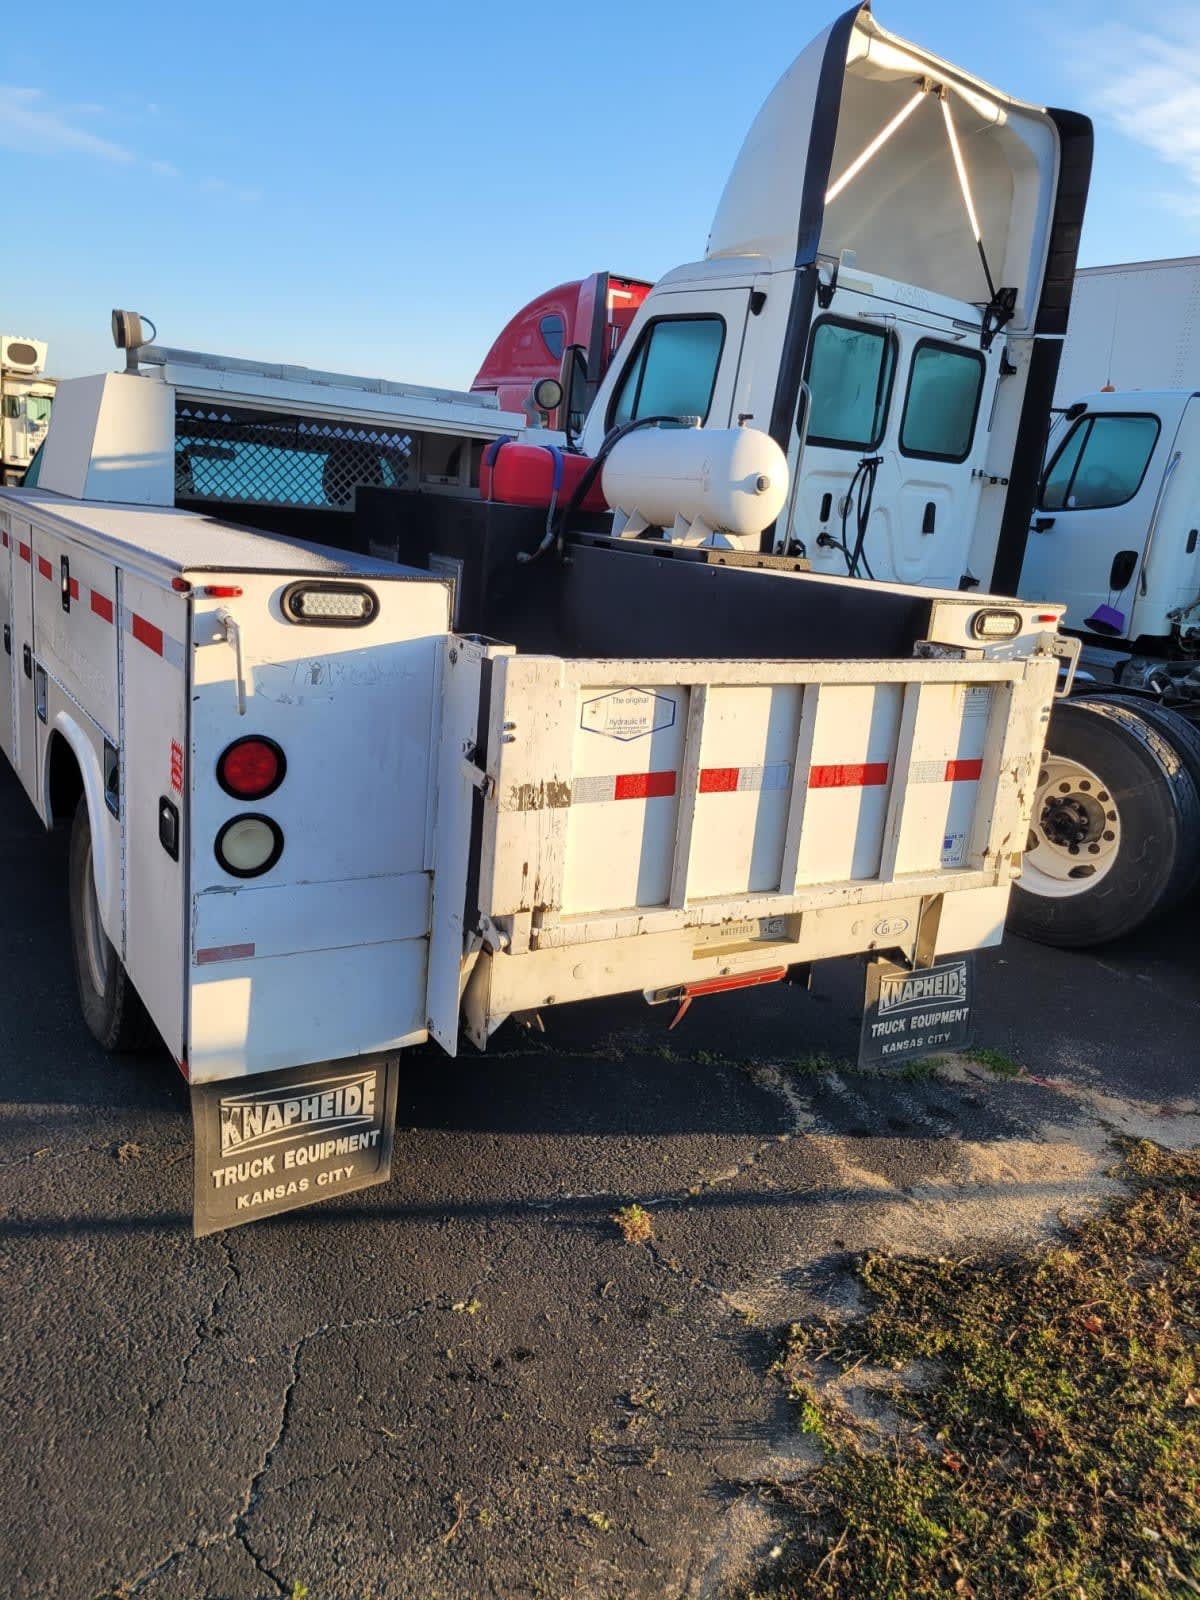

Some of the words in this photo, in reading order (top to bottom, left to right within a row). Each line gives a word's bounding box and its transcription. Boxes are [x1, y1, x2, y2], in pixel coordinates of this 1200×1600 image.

[612, 697, 624, 705] The
[625, 697, 649, 706] original
[609, 717, 638, 726] hydraulic
[879, 966, 967, 1010] KNAPHEIDE
[871, 1018, 906, 1038] TRUCK
[910, 1007, 970, 1030] EQUIPMENT
[881, 1038, 924, 1054] KANSAS
[927, 1032, 951, 1045] CITY
[220, 1077, 377, 1148] KNAPHEIDE
[212, 1154, 276, 1189] TRUCK
[283, 1129, 381, 1170] EQUIPMENT
[236, 1177, 310, 1210] KANSAS
[316, 1164, 355, 1186] CITY
